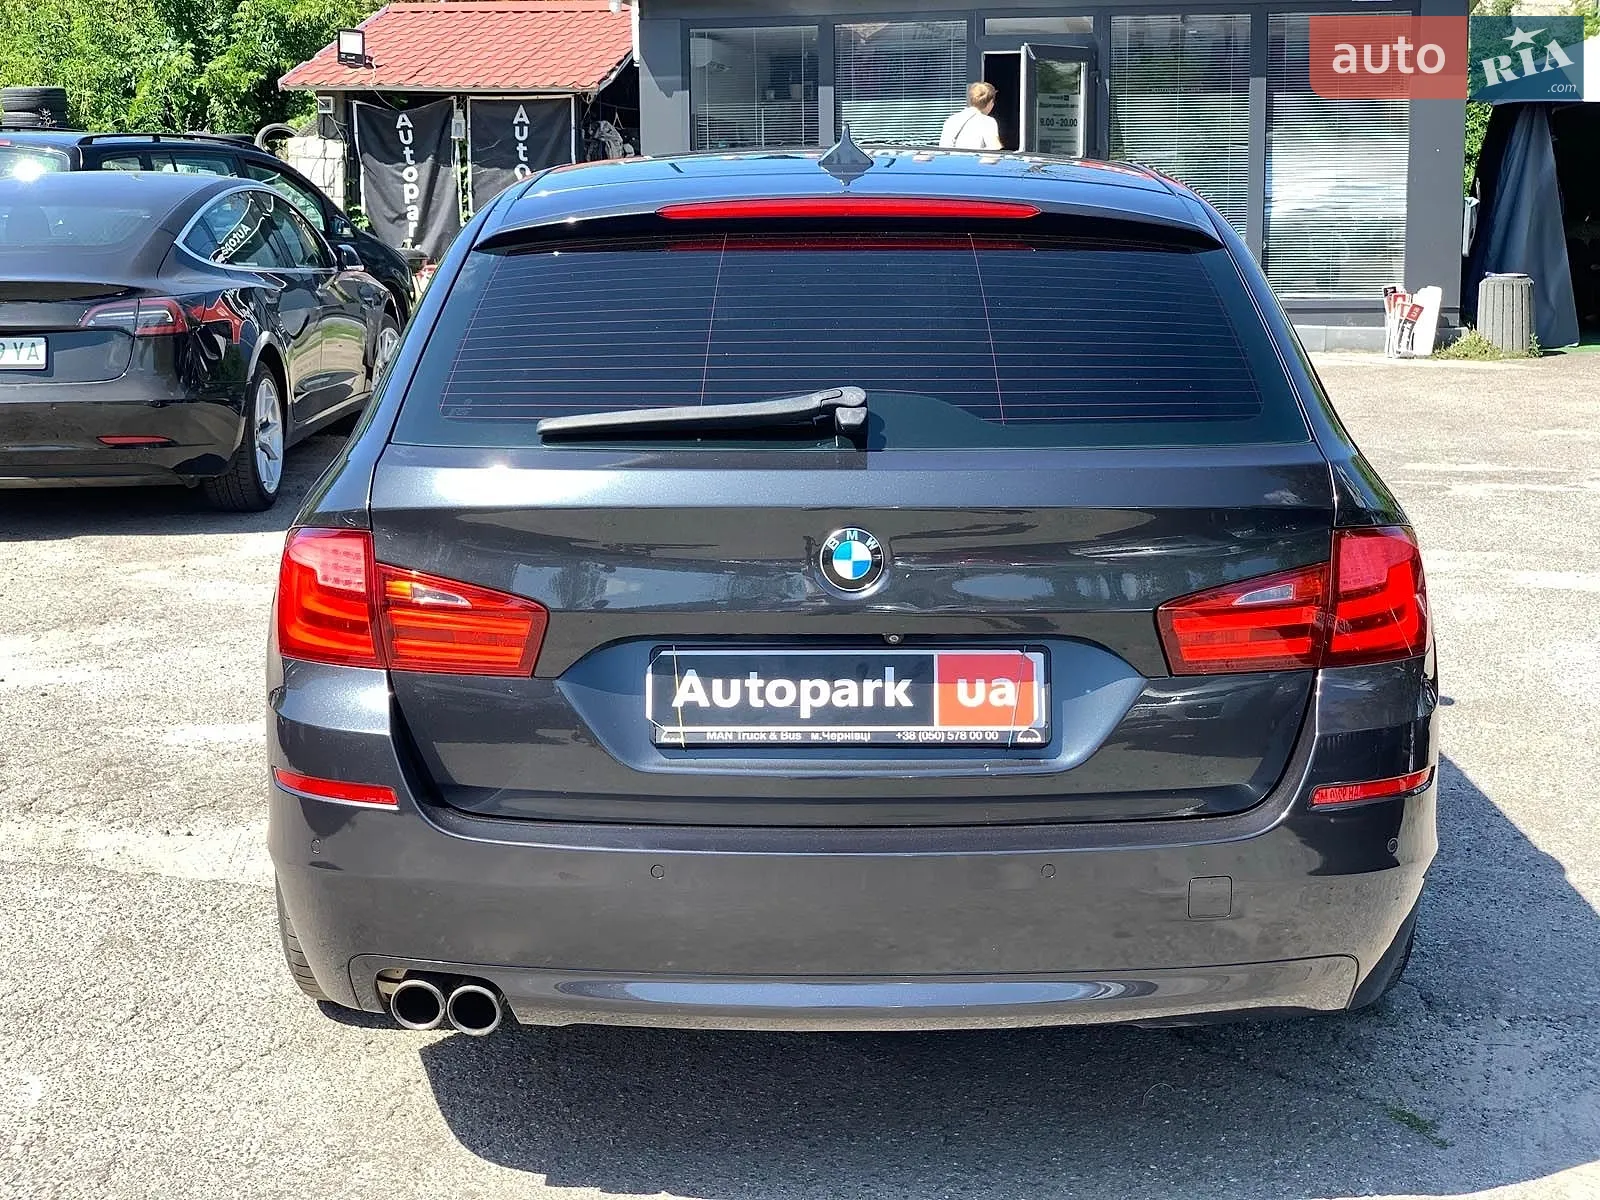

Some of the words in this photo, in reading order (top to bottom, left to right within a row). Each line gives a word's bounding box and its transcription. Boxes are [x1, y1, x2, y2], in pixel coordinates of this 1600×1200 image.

[13, 342, 40, 361] YA
[827, 530, 879, 551] BMW
[672, 667, 914, 719] Autopark
[956, 677, 1017, 708] ua
[706, 731, 733, 741] MAN
[737, 731, 767, 741] Truck
[769, 731, 778, 741] &
[780, 731, 802, 741] Bus
[895, 731, 917, 741] +38
[918, 731, 945, 743] (050)
[947, 731, 967, 741] 578
[969, 731, 983, 741] 00
[984, 731, 999, 741] 00
